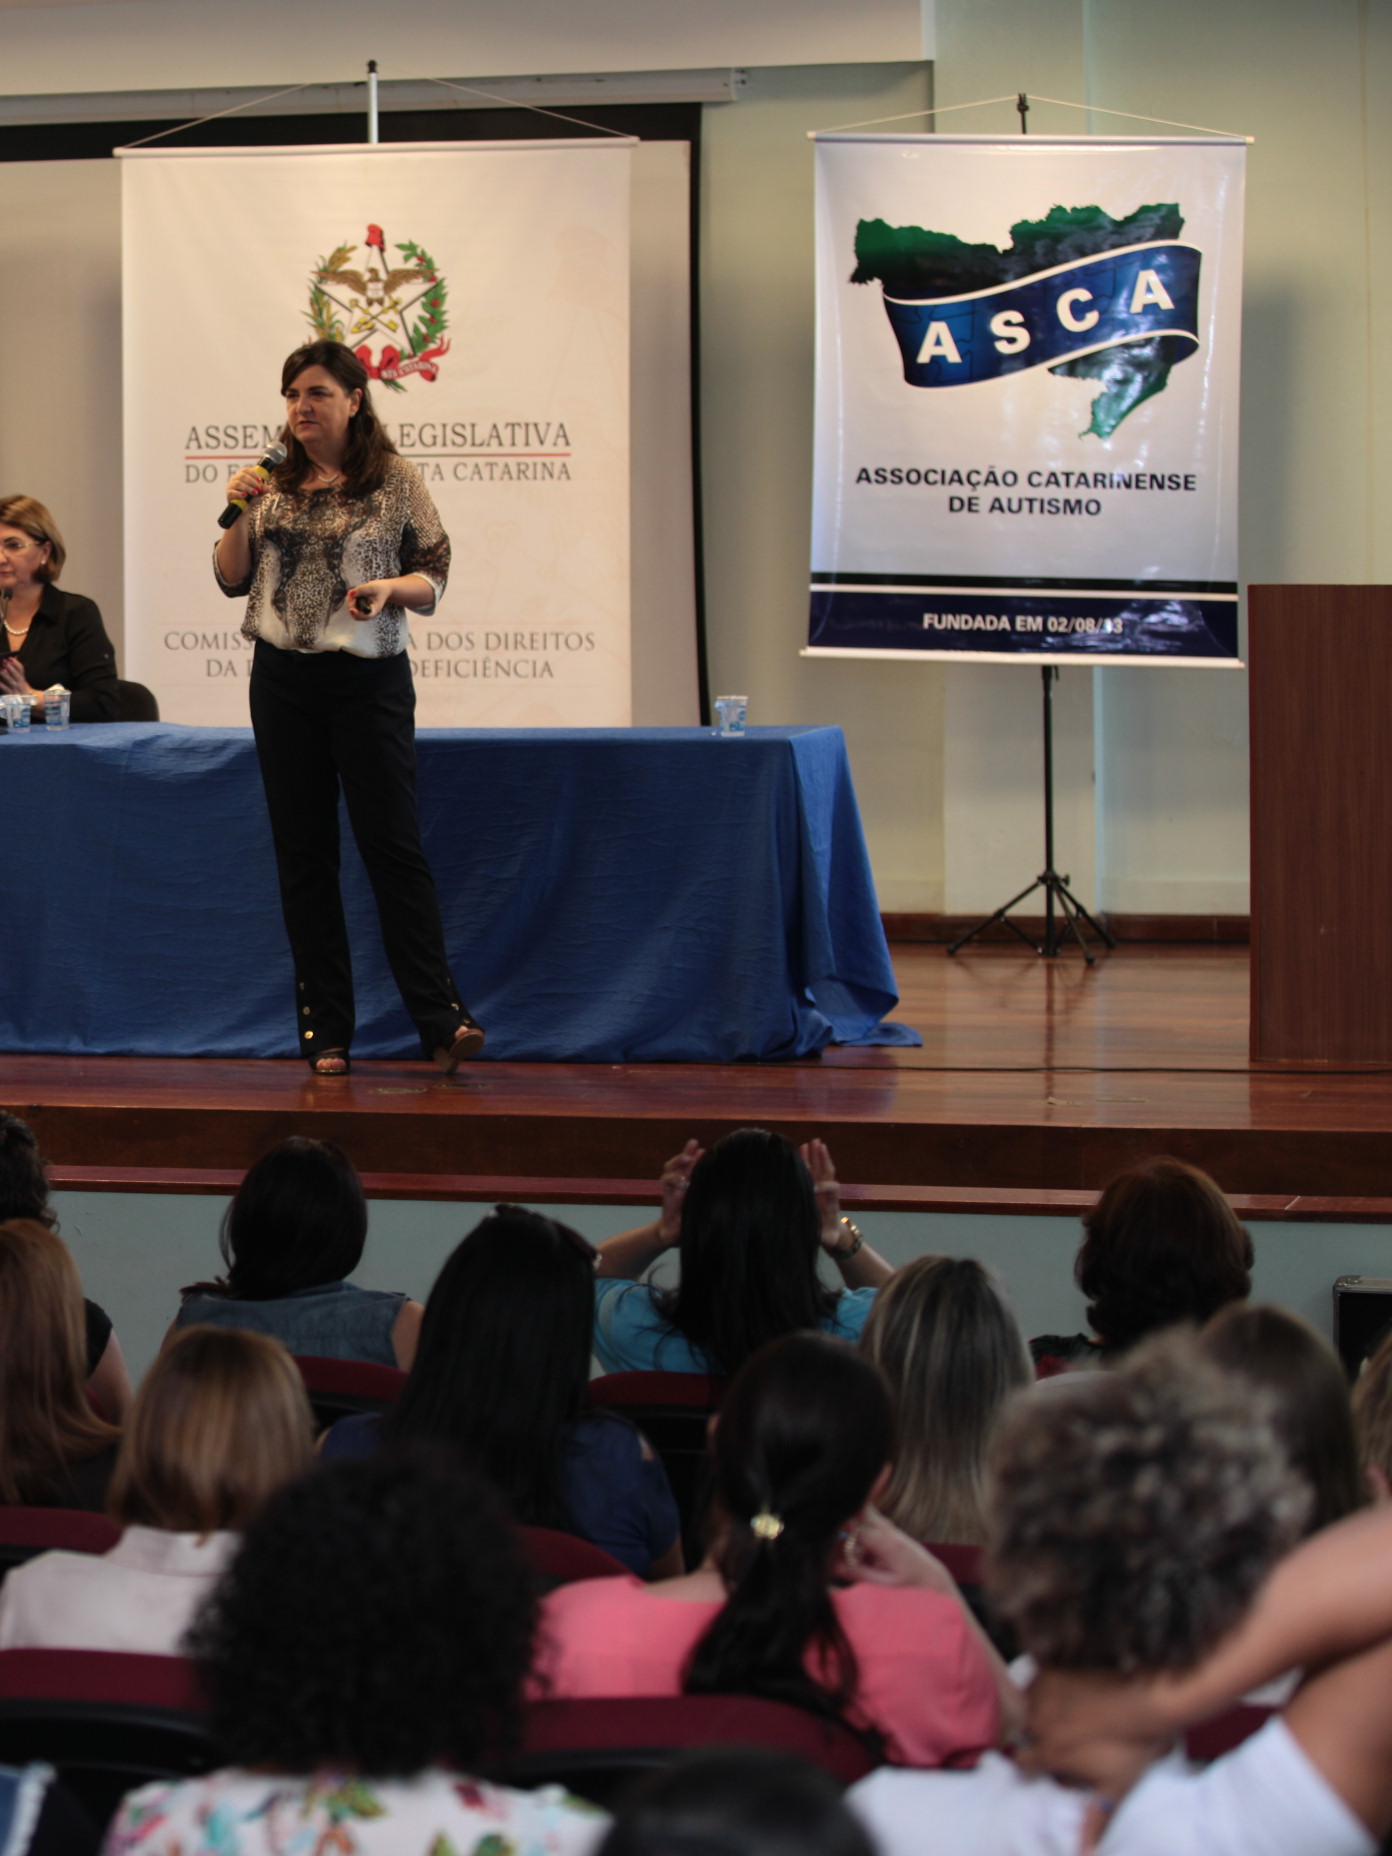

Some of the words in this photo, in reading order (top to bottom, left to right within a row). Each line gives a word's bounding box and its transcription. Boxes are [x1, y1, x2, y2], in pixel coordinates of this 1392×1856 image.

[916, 269, 1175, 365] ASCA
[185, 424, 284, 450] ASSEM
[185, 464, 218, 484] DO
[453, 461, 572, 482] CATARINA
[856, 465, 1019, 492] ASSOCIAÇÃO
[1027, 470, 1198, 491] CATARINENSE
[948, 496, 980, 513] DE
[989, 497, 1102, 516] AUTISMO
[923, 613, 1010, 631] FUNDADA
[1015, 615, 1043, 632] EM
[164, 631, 253, 651] COMIS
[427, 631, 475, 651] DOS
[485, 631, 595, 651] DIREITOS
[206, 658, 238, 678] DA
